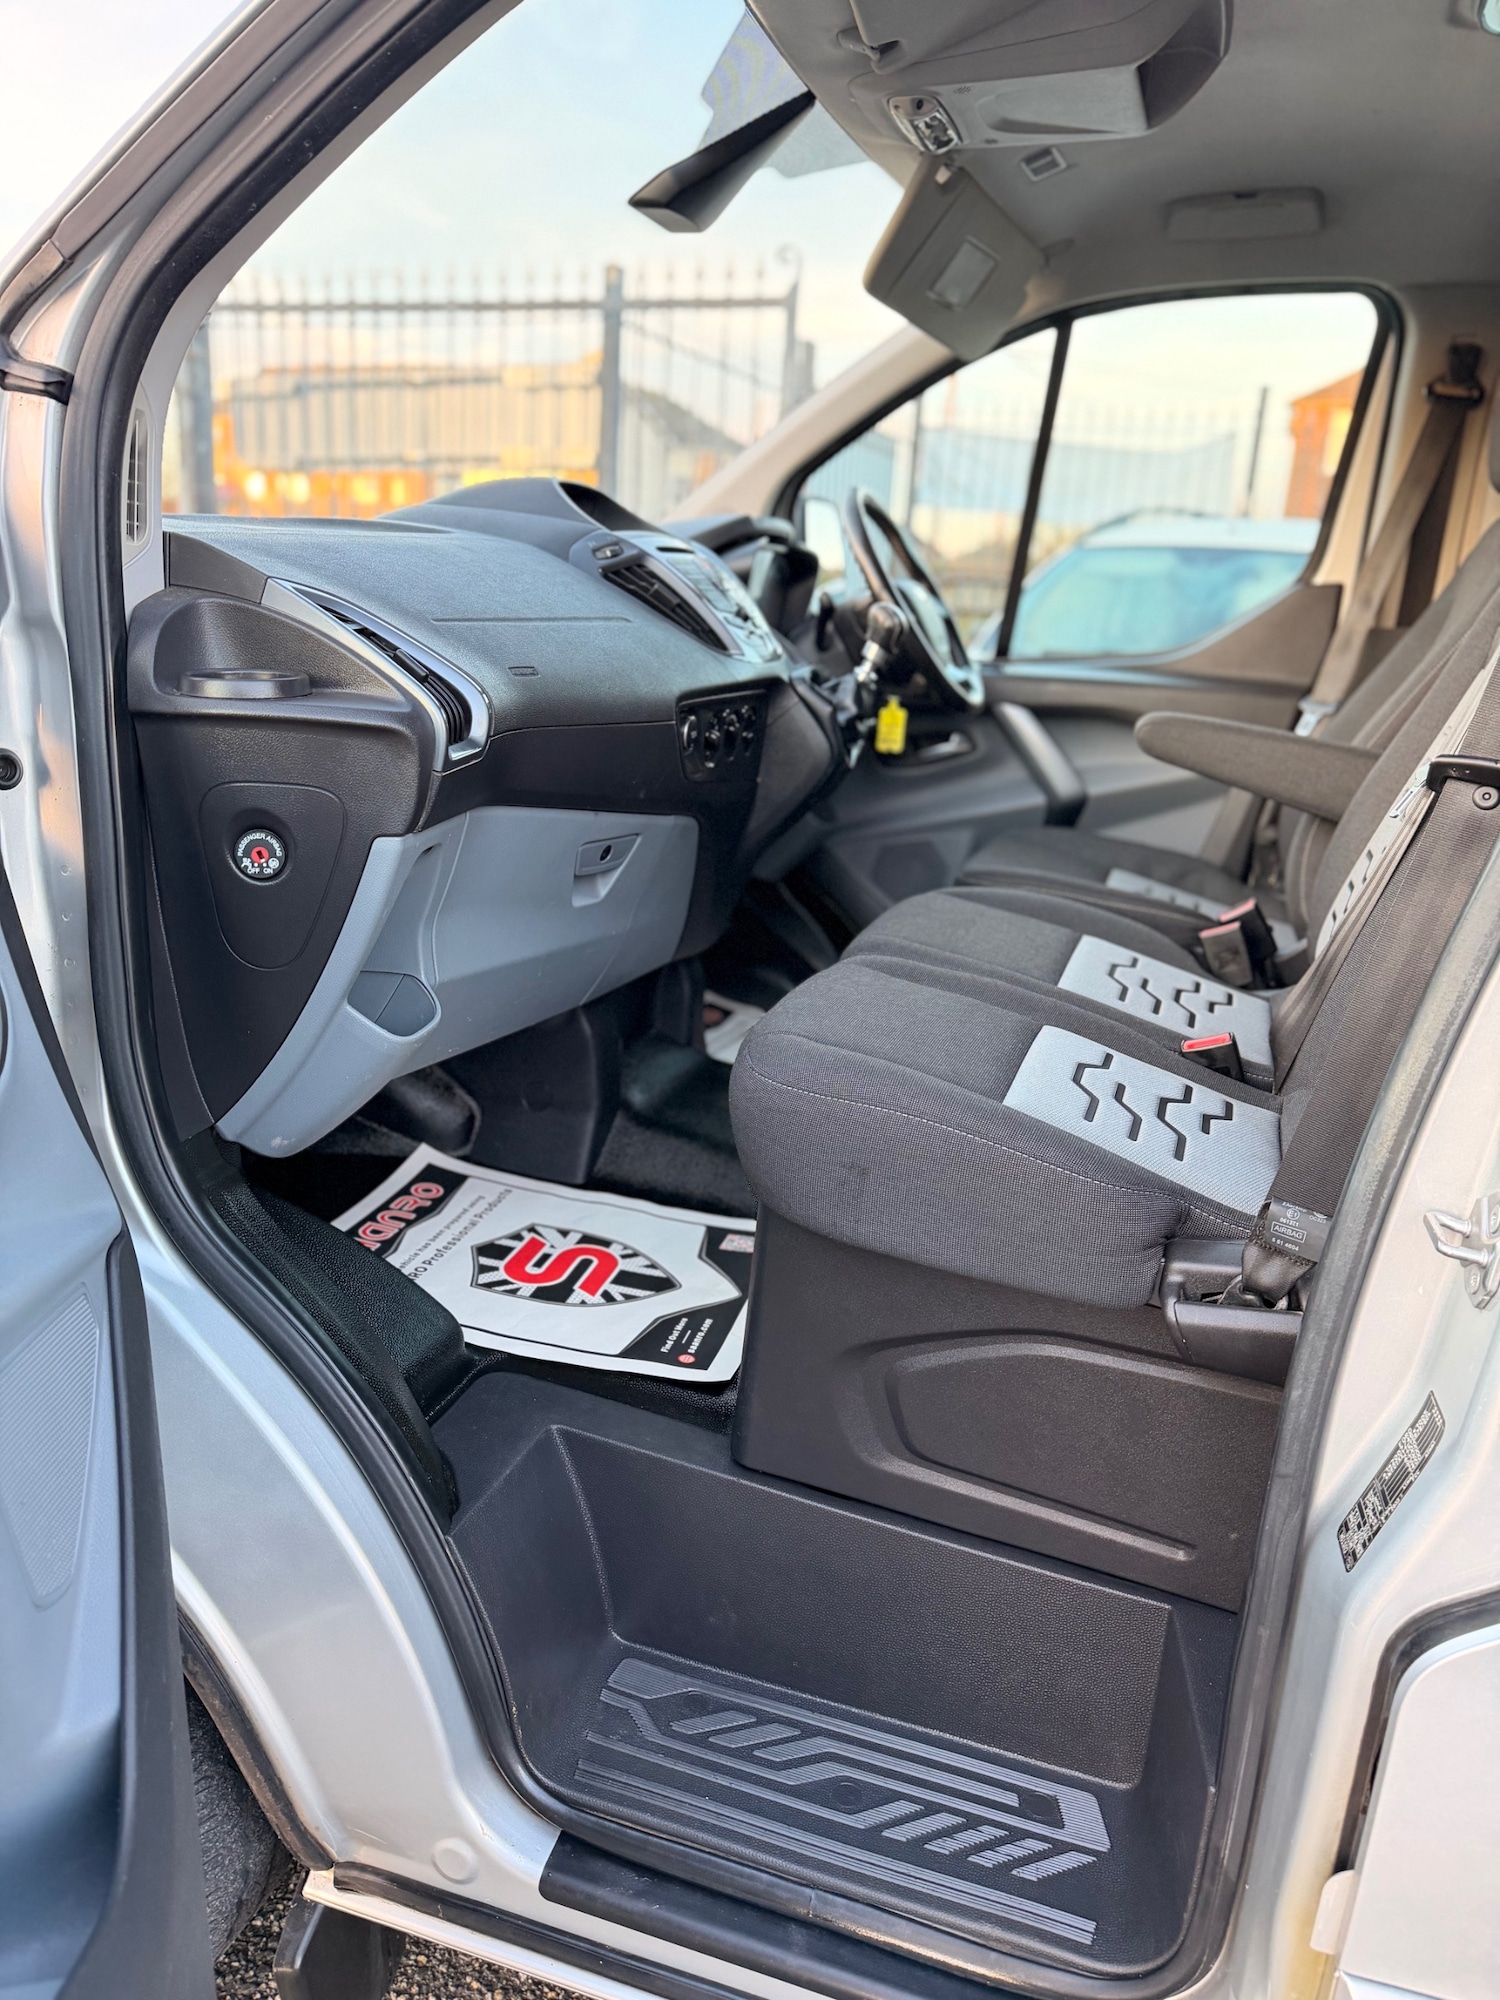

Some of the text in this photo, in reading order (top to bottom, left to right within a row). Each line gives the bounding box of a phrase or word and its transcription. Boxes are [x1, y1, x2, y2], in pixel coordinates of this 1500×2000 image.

[237, 833, 283, 857] PASSENGER AIRBAG
[416, 1242, 432, 1253] has
[428, 1230, 446, 1243] been
[421, 1219, 481, 1266] Professional
[473, 1188, 513, 1219] Products
[1273, 1225, 1304, 1240] AIRBAG
[502, 1233, 620, 1298] S
[660, 1340, 675, 1353] Find
[674, 1317, 689, 1331] More
[687, 1318, 714, 1354] saanro.com
